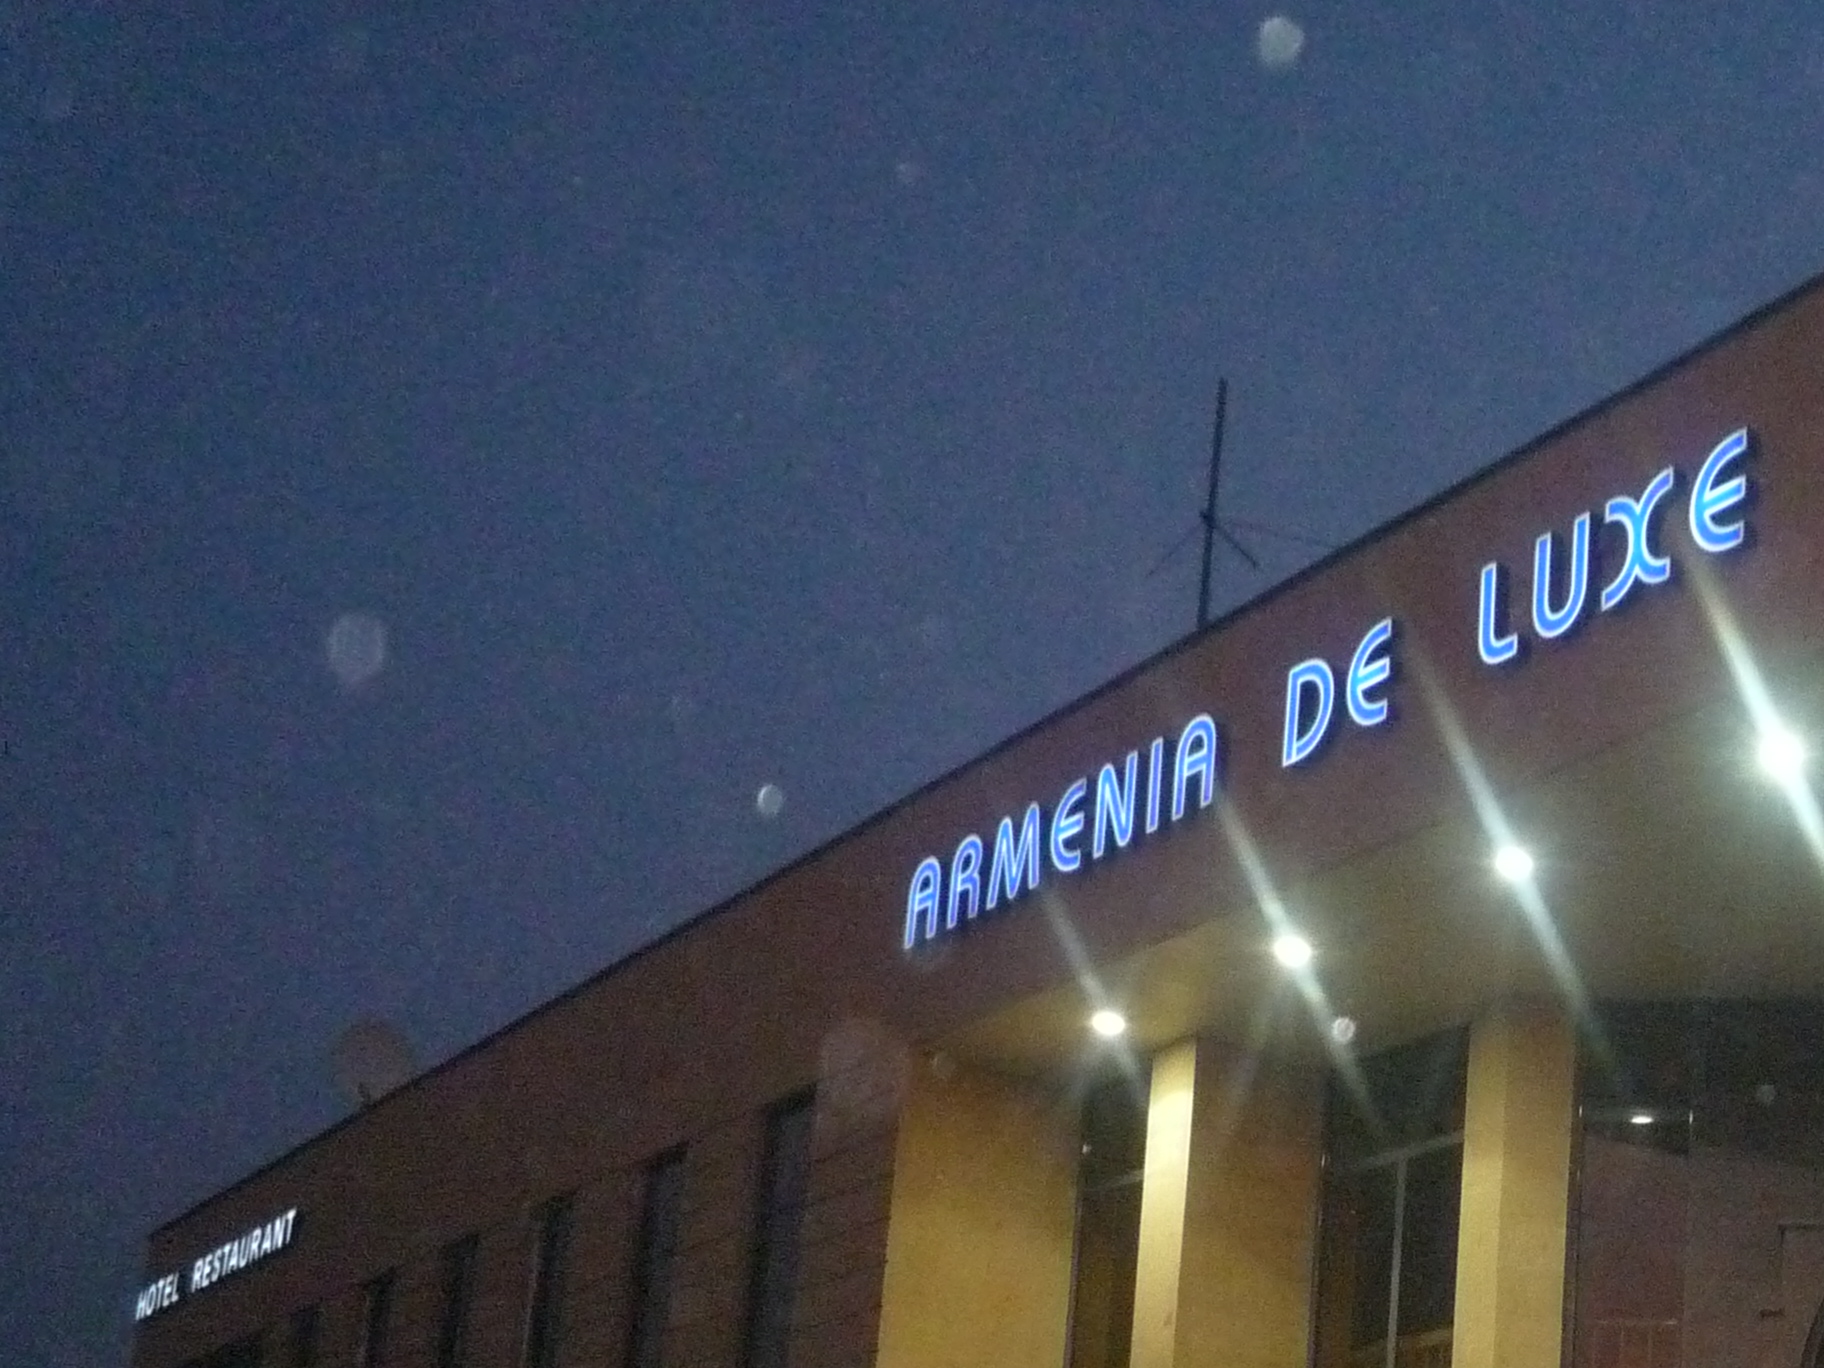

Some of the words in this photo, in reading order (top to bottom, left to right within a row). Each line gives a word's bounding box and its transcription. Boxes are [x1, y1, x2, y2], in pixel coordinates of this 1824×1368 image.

[903, 713, 1218, 949] ARMENIA
[1283, 617, 1392, 768] DE
[1478, 428, 1749, 665] LUXE
[135, 1272, 180, 1321] HOTEL
[191, 1206, 297, 1293] RESTAURANT
